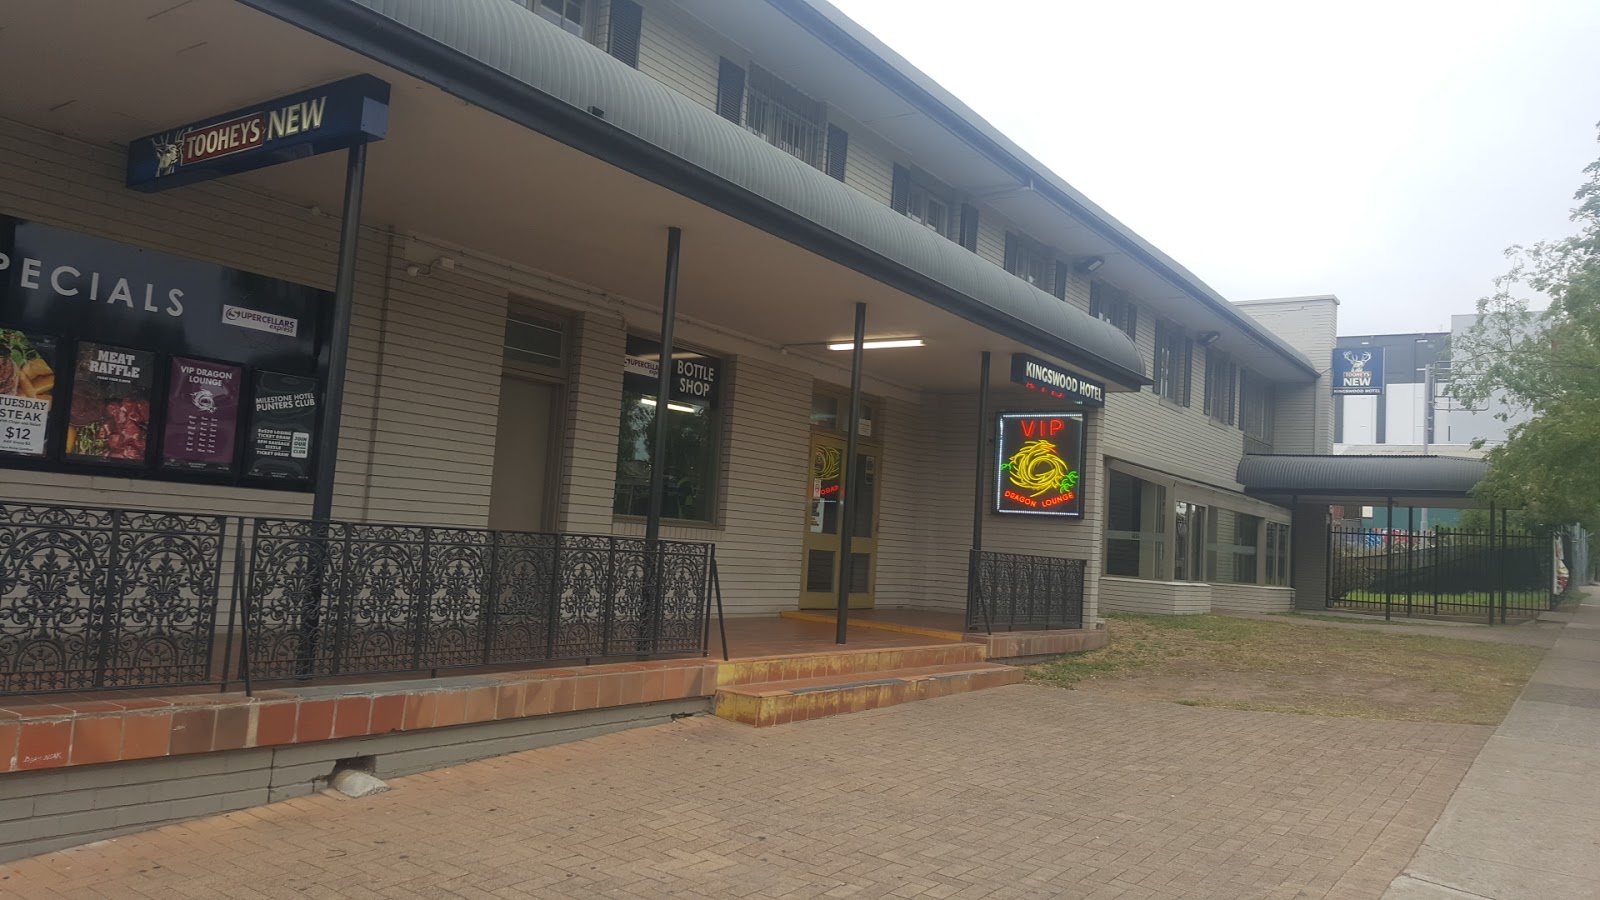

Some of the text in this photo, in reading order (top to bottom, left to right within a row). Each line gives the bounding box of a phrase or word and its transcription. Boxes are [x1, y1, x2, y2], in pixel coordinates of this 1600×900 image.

[185, 96, 328, 160] TOOHEYS NEW
[269, 324, 294, 334] express
[97, 350, 136, 366] MEAT
[89, 360, 140, 379] RAFFLE
[180, 365, 233, 380] VIP DRAGON
[677, 360, 714, 382] BOTTLE
[189, 375, 223, 387] LOUNGE
[679, 377, 710, 397] SHOP
[1026, 361, 1078, 393] KINGSWOOD
[1079, 381, 1103, 402] HOTEL
[1343, 378, 1371, 386] NEW
[0, 397, 47, 411] TUESDAY
[256, 392, 315, 404] MILESTONE HOTEL
[256, 398, 316, 412] PUNTERS CLUB
[0, 408, 42, 422] STEAK
[5, 425, 31, 440] $12
[1021, 419, 1065, 437] VIP
[1004, 490, 1075, 508] DRAGON LOUNGE
